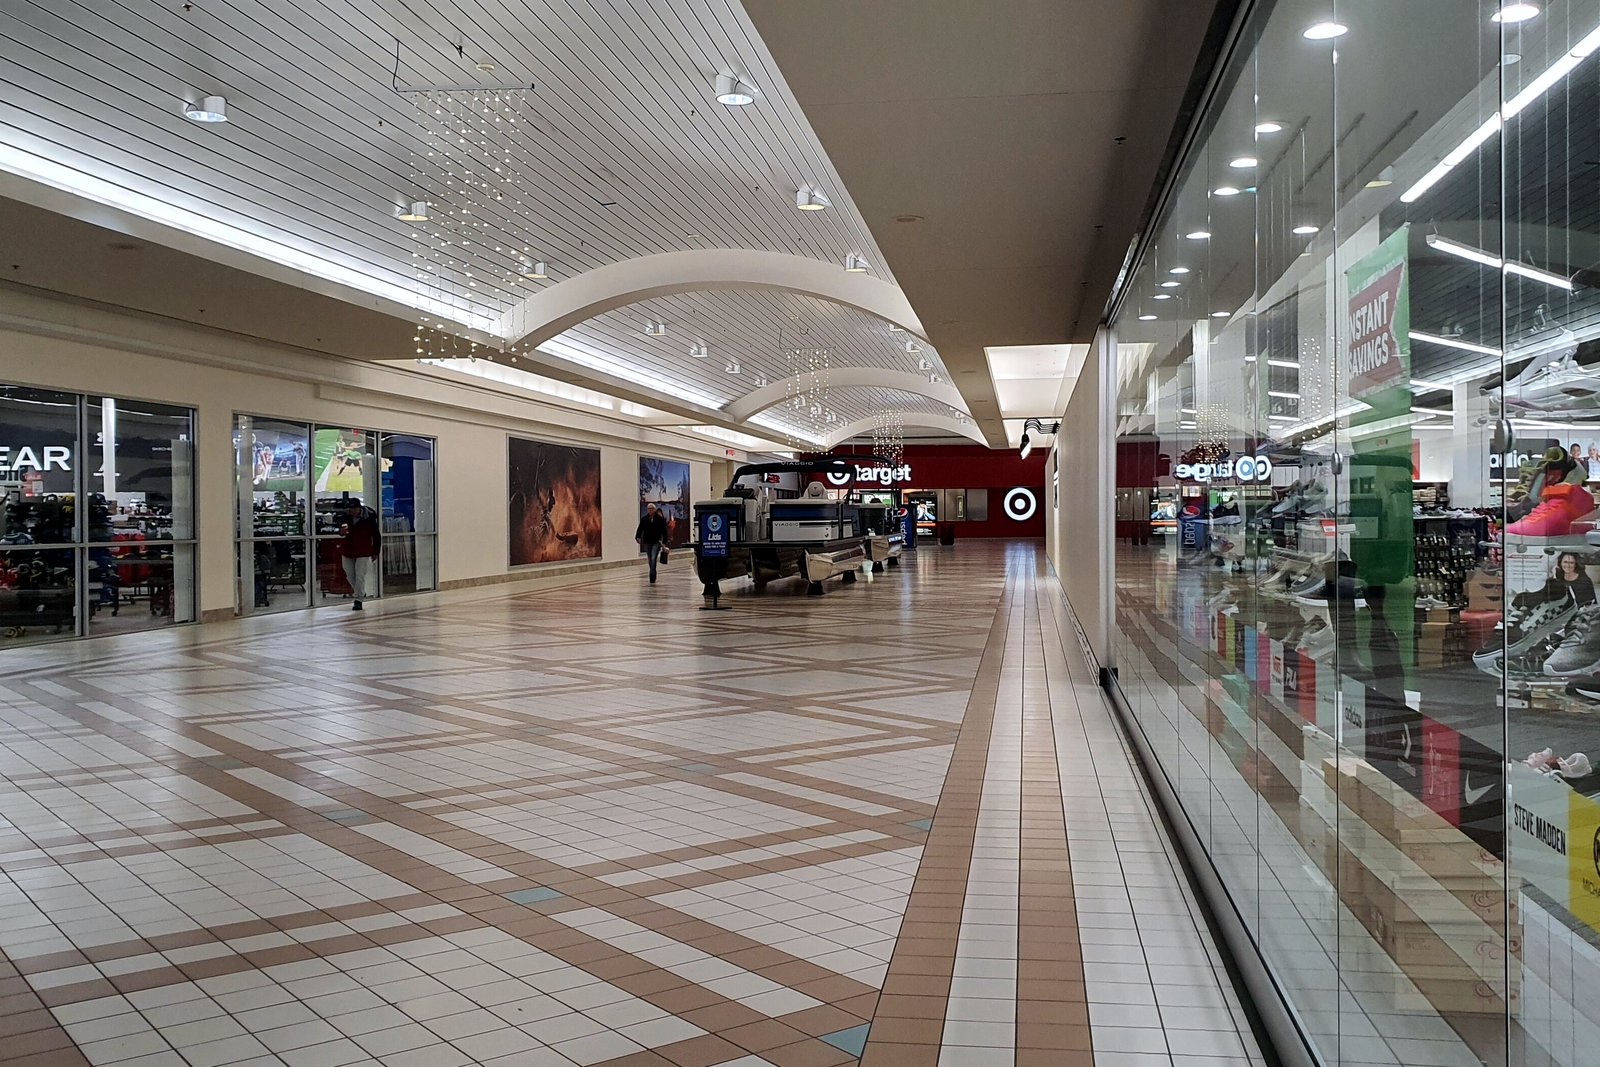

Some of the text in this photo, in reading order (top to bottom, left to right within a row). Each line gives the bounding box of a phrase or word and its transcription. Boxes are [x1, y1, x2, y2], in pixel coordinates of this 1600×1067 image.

[1349, 291, 1389, 342] NSTANT
[854, 464, 912, 485] target
[707, 533, 722, 541] Lids
[900, 521, 908, 546] pepsi
[1344, 705, 1363, 729] adidas
[1513, 803, 1566, 856] STEVE MADDEN
